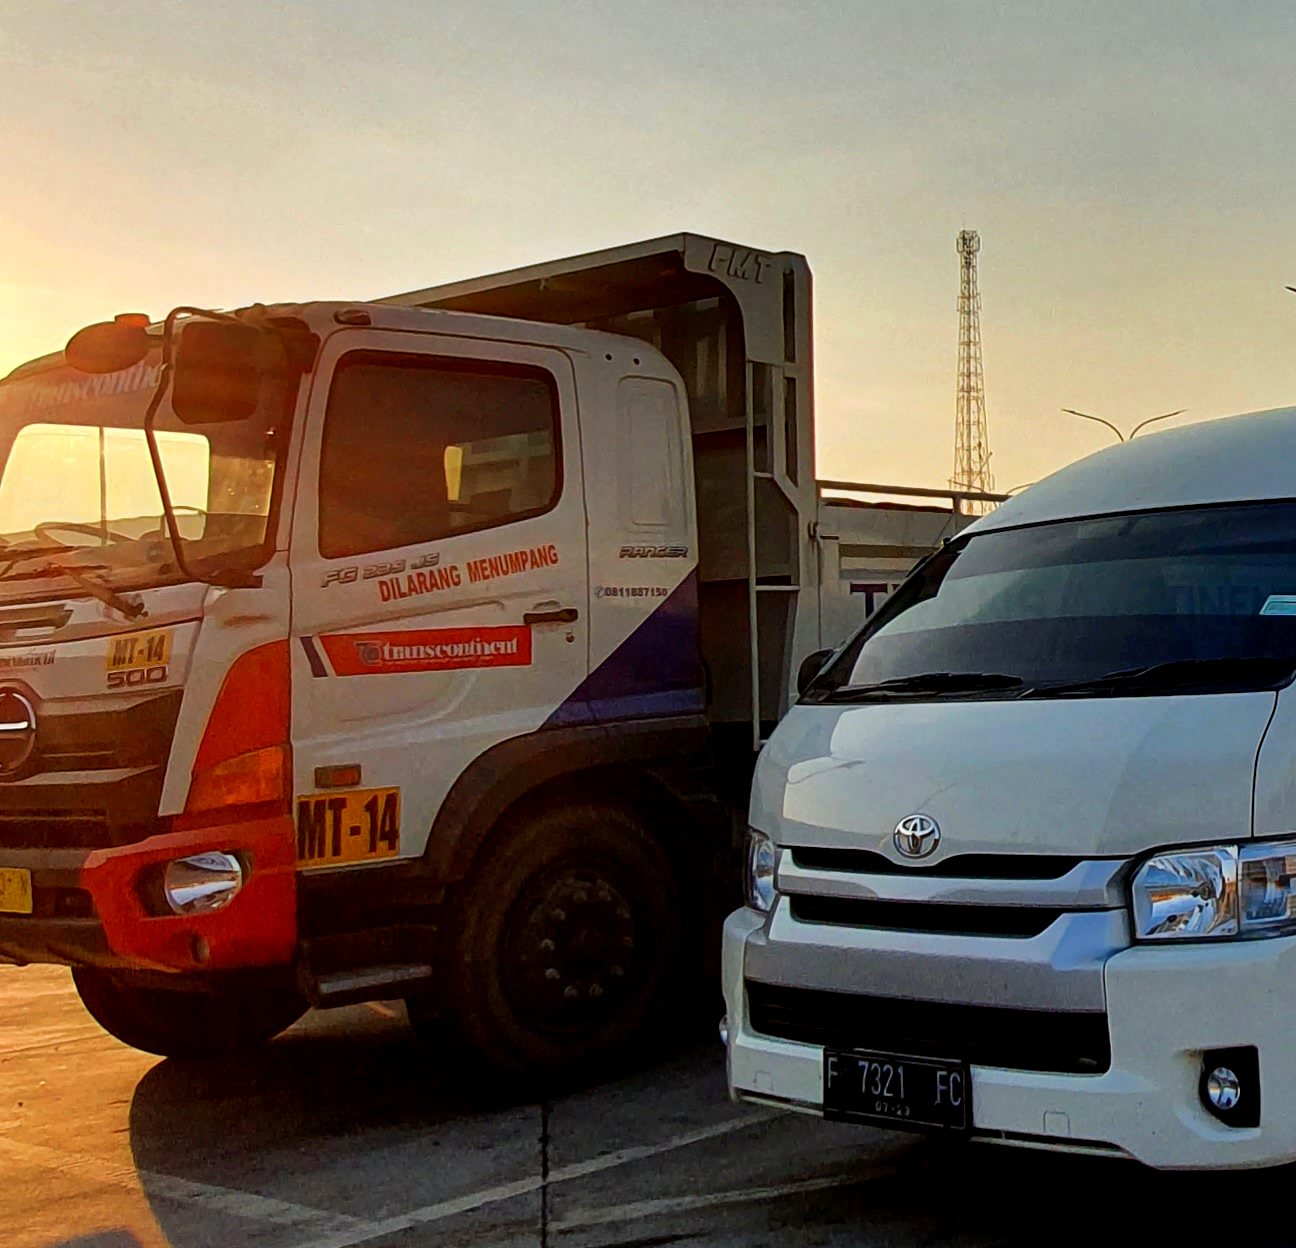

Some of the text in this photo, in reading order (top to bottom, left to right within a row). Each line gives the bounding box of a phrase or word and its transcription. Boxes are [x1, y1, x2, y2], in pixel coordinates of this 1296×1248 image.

[619, 546, 688, 559] RANGER
[320, 566, 358, 588] FG
[378, 544, 559, 602] DILARANG MENUMPANG
[112, 634, 166, 667] MT-14
[383, 636, 518, 661] transcontinent
[107, 665, 168, 690] 500
[298, 791, 399, 861] MT-14
[827, 1056, 963, 1107] F 7321 FC
